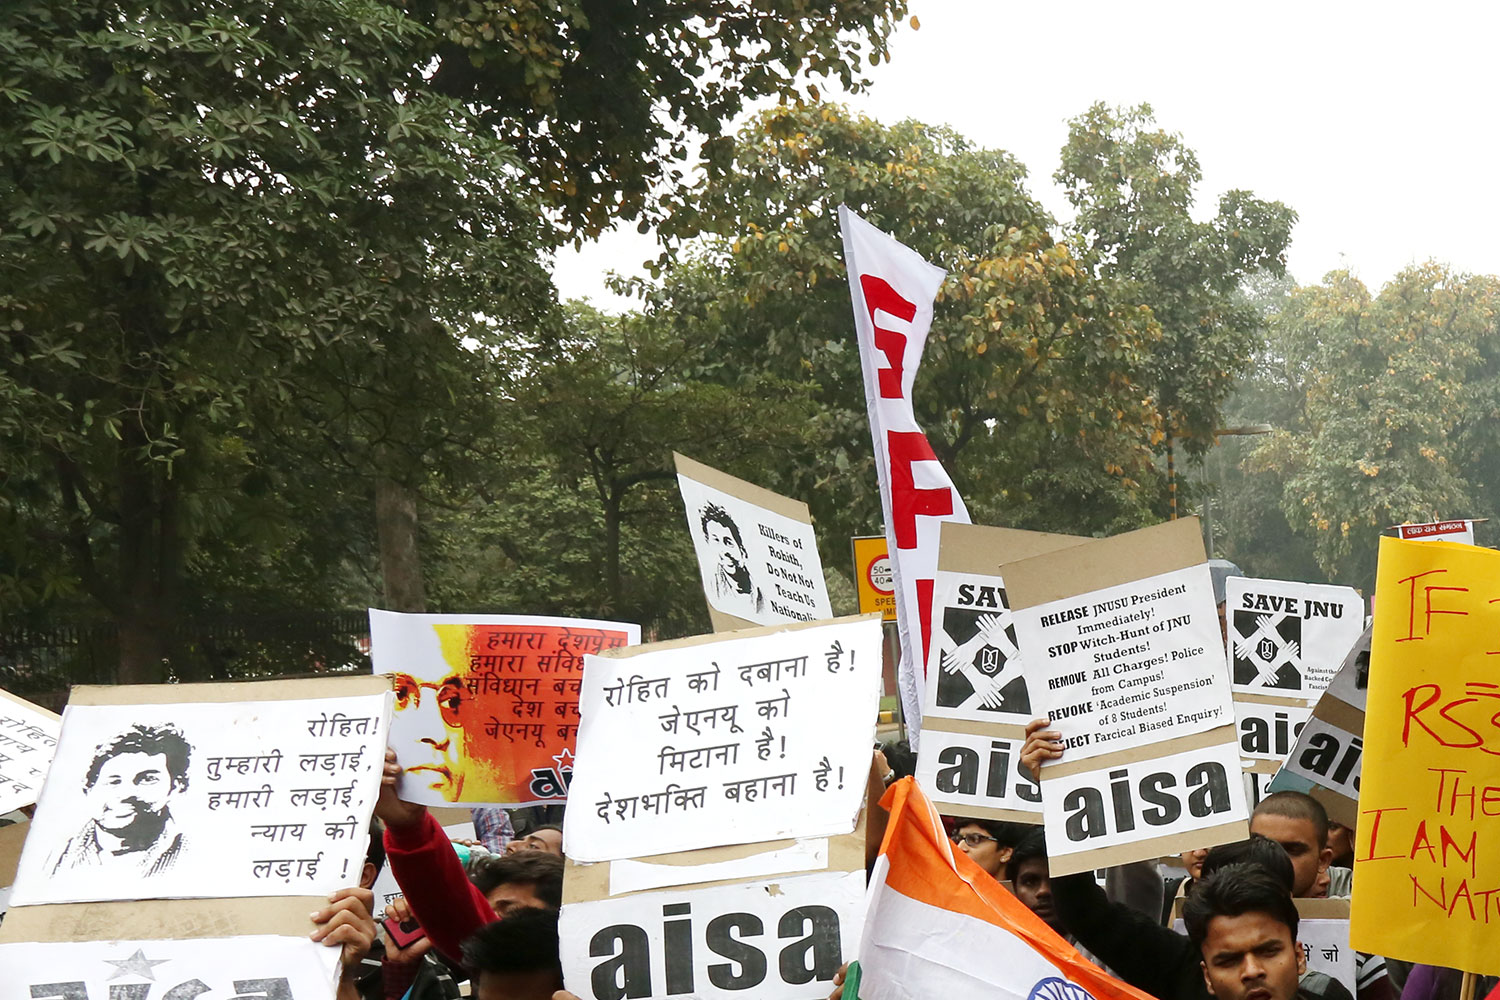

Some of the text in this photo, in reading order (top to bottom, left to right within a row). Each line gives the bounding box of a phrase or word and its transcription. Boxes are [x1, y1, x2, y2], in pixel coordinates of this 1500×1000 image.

[757, 523, 803, 550] Killers of
[768, 545, 803, 571] Rohith,
[873, 566, 885, 574] 50
[766, 562, 815, 590] Do Not Not
[874, 577, 885, 585] 40
[775, 583, 816, 608] Teach Us
[875, 597, 896, 606] SPEE
[1040, 584, 1187, 628] RELEASE JNUSU President
[1242, 592, 1344, 620] SAVE JNU
[1395, 569, 1469, 642] IF
[770, 599, 817, 622] Nationali
[1077, 607, 1156, 635] Immediately!
[487, 631, 547, 650] हमारा
[1048, 615, 1192, 658] STOP Witch-Hunt of JNU
[470, 655, 527, 673] हमारा
[1093, 641, 1151, 663] Students!
[603, 675, 671, 707] रोहित
[686, 662, 721, 694] को
[738, 655, 809, 687] दबाना
[1048, 646, 1204, 691] REMOVE All Charges! Police
[466, 671, 541, 696] संविधान
[1091, 670, 1165, 697] from Campus!
[512, 694, 544, 718] देश
[658, 689, 791, 736] जेएनयू को
[1048, 702, 1093, 722] REVOKE
[1099, 702, 1168, 726] of 8 Students!
[307, 712, 380, 737] रोहित!
[484, 716, 546, 748] जेएनयू
[1052, 705, 1223, 752] JECT Farcical Biased Enquiry!
[1241, 712, 1306, 756] ai
[206, 749, 284, 782] तुम्हारी
[657, 742, 740, 775] मिटाना
[936, 740, 1043, 803] ais
[1299, 732, 1363, 793] ai
[207, 784, 275, 811] हमारी
[595, 783, 708, 824] देशभक्ति
[723, 773, 797, 803] बहाना
[1063, 762, 1231, 842] aisa
[250, 815, 359, 842] न्याय की
[1356, 807, 1408, 862] I
[1410, 819, 1477, 879] AM
[252, 851, 324, 884] लड़ाई
[1321, 944, 1339, 962] जो
